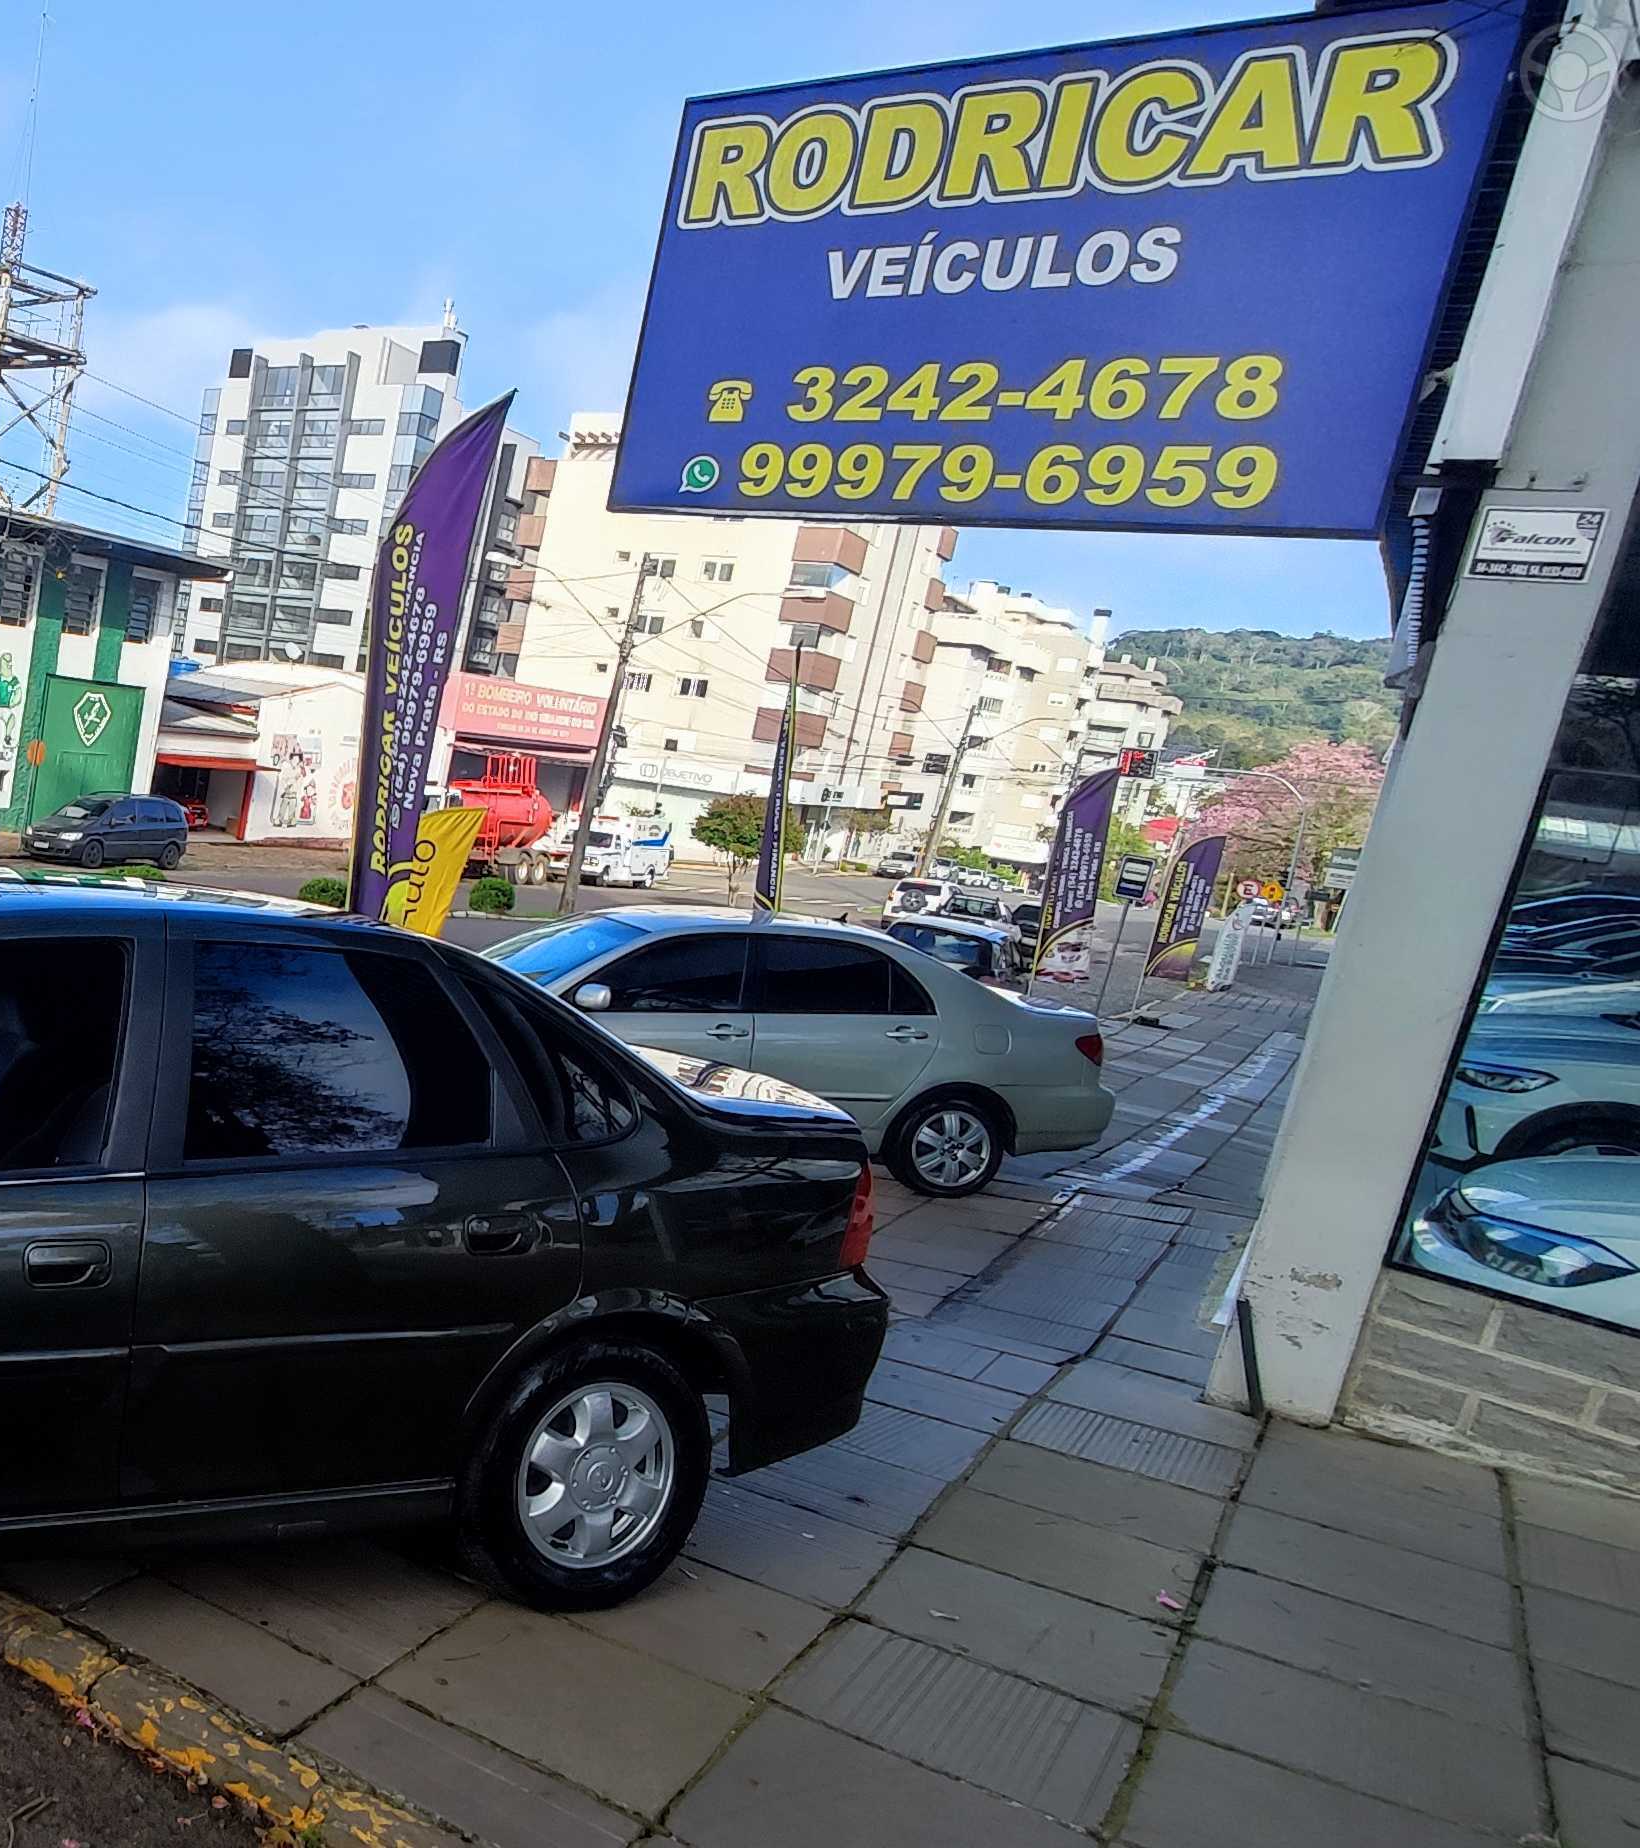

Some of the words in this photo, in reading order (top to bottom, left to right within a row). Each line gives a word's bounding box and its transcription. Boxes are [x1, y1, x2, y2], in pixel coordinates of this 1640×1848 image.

[678, 32, 1458, 229] RODRICAR
[827, 226, 1182, 301] VEÍCULOS
[786, 354, 1284, 424] 3242-4678
[737, 445, 1279, 508] 99979-6959
[1496, 528, 1576, 546] Falcon
[396, 586, 427, 714] 3242-4678
[402, 603, 438, 746] 99979-6959
[370, 710, 396, 875] RODRICAR
[384, 524, 414, 695] VEÍCULOS
[403, 752, 422, 810] Nova
[415, 685, 438, 747] Prata
[433, 631, 448, 664] RS
[478, 684, 532, 706] BOMBEIRO
[536, 693, 598, 716] VOLUNTÁRIO
[396, 753, 410, 801] (54)
[403, 840, 436, 926] uto
